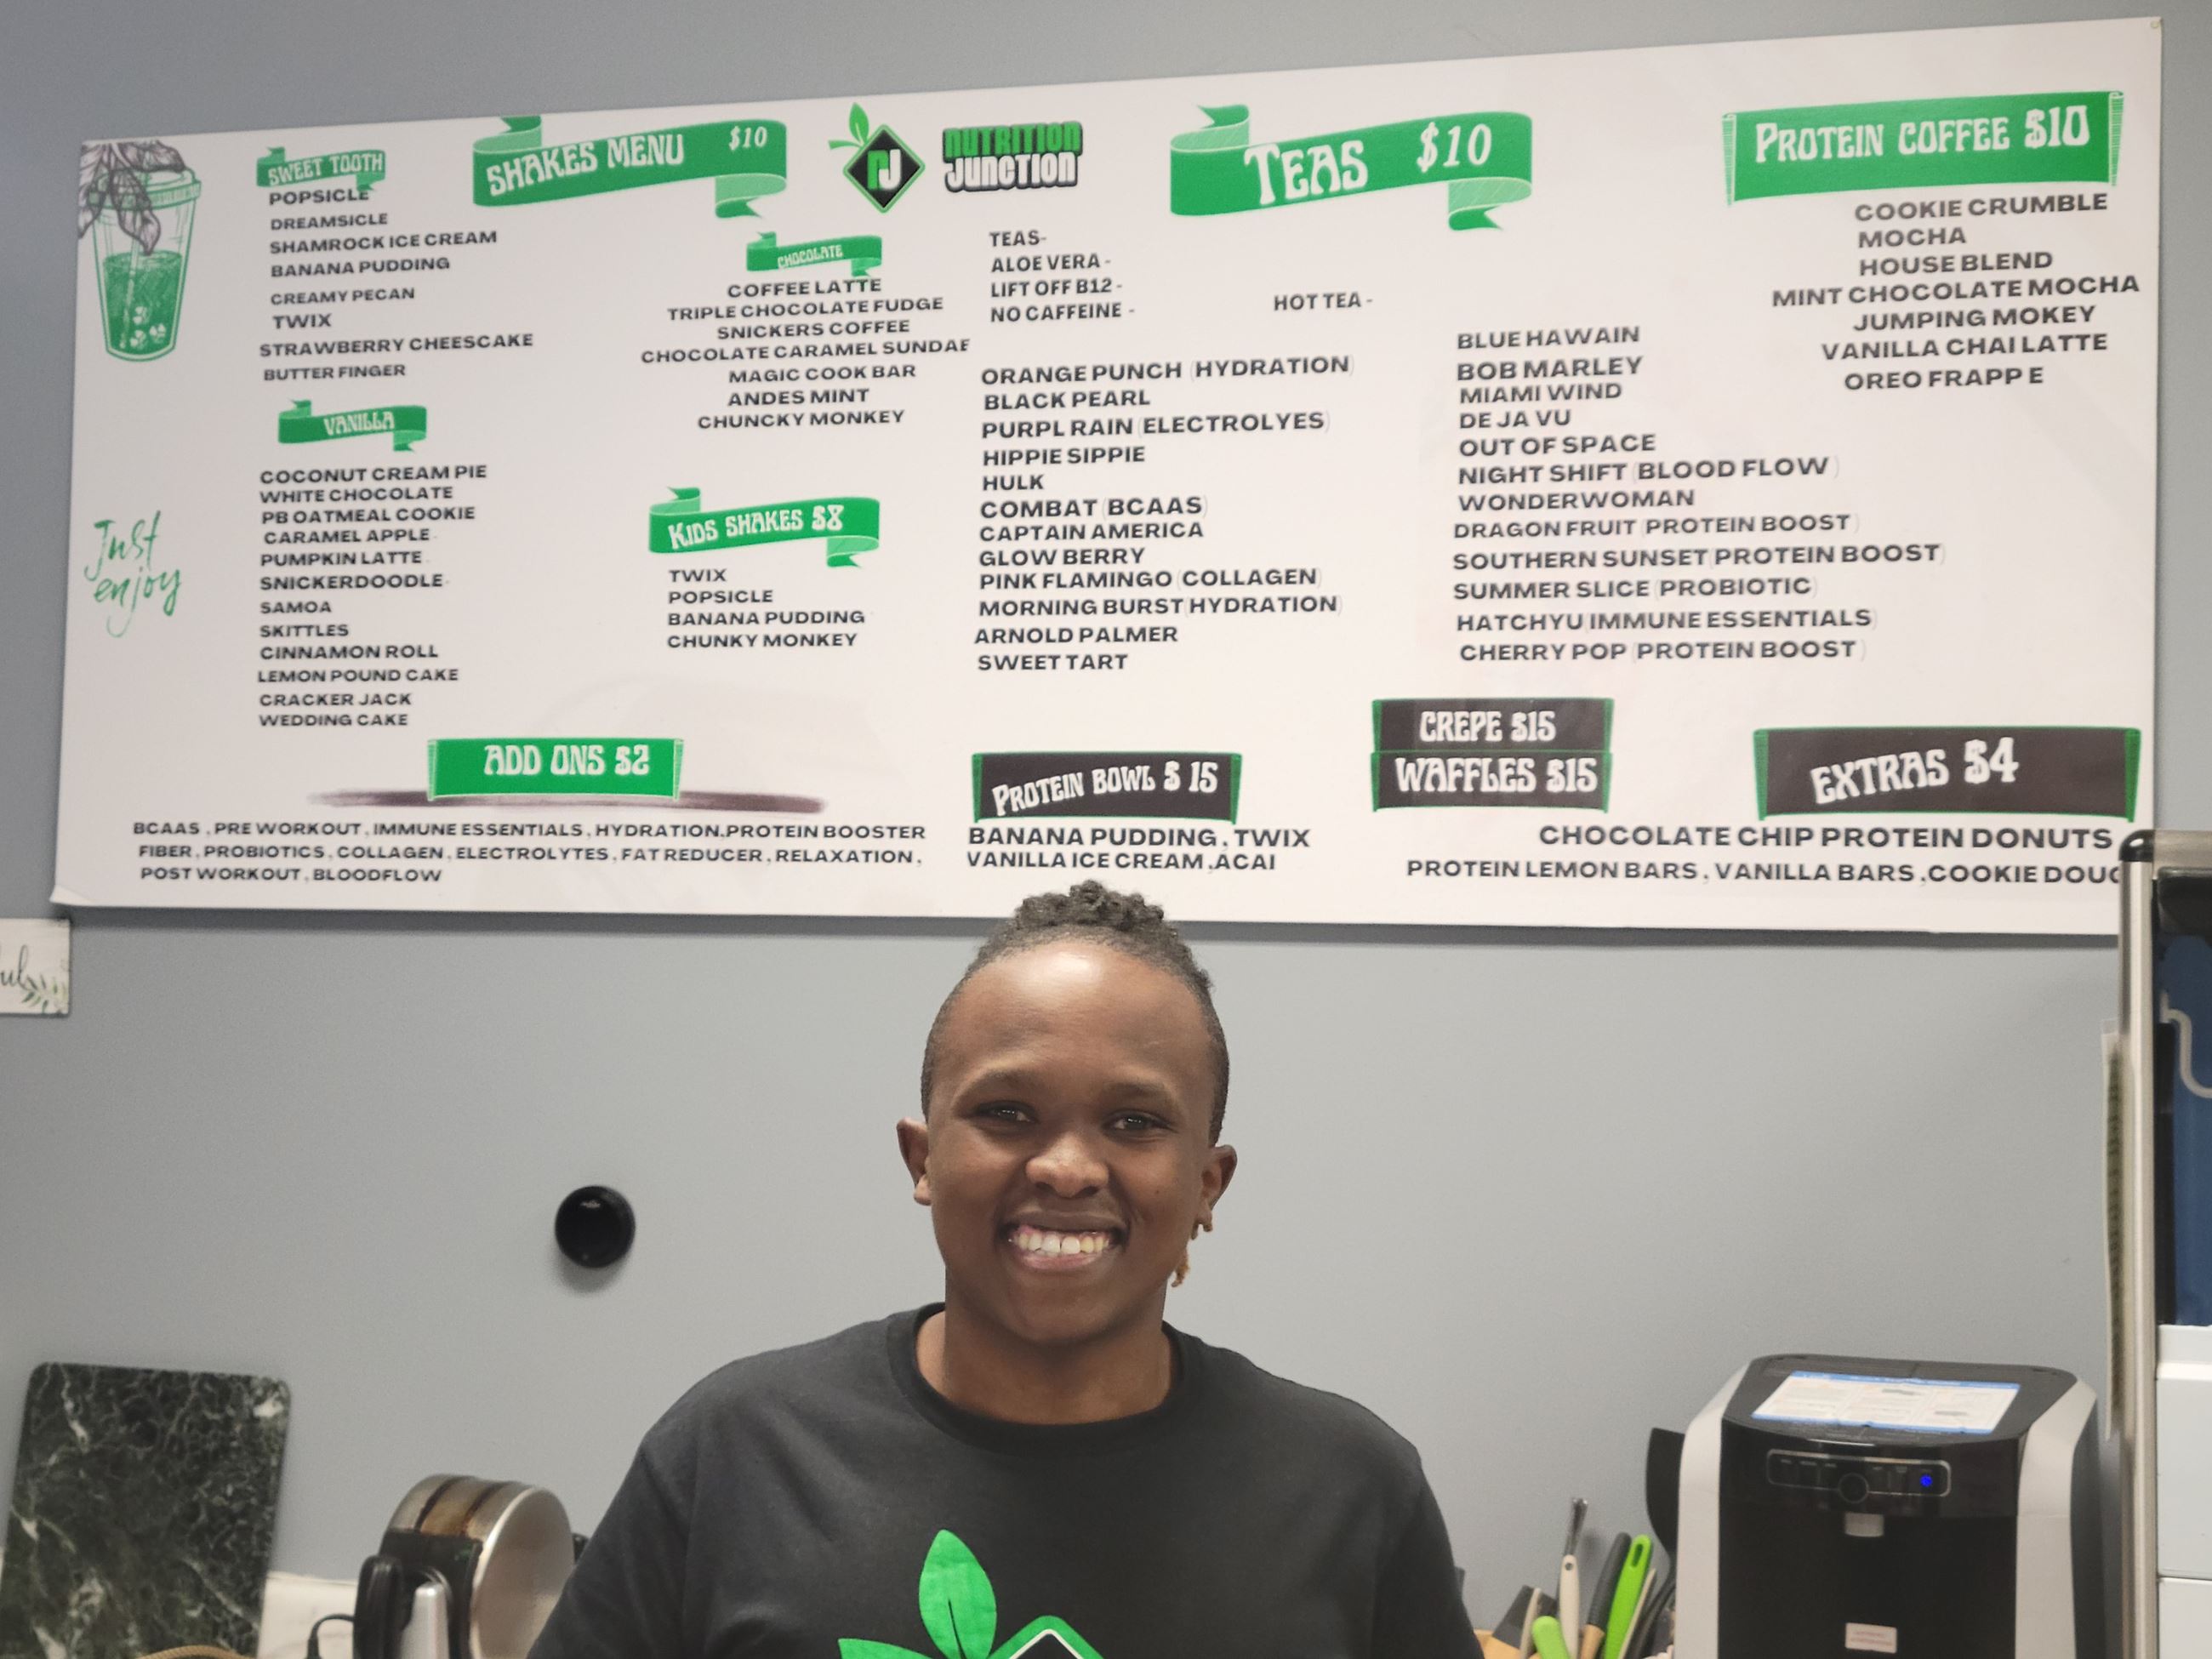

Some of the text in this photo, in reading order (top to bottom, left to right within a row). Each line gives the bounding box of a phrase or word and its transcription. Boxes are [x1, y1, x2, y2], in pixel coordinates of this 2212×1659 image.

[1755, 105, 2090, 162] PROTEIN COFFEE $10
[268, 152, 383, 185] SWEET TOOTH
[487, 126, 767, 197] SHAKES MENU $10
[1244, 122, 1492, 205] TEAS $10
[270, 188, 369, 205] POPSICLE
[1855, 193, 2107, 221] COOKIE CRUMBLE
[271, 214, 387, 231] DREAMSICLE
[271, 231, 497, 254] SHAMROCK ICE CREAM
[1859, 227, 1966, 248] MOCHA
[778, 245, 843, 269] CHOCOLATE
[1860, 252, 2053, 276] HOUSE BLEND
[271, 257, 450, 277] BANANA PUDDING
[271, 288, 414, 305] CREAMY PECAN
[727, 279, 881, 298] COFFEE LATTE
[1773, 276, 2140, 306] MINT CHOCOLATE MOCHA
[668, 298, 943, 320] TRIPLE CHOCOLATE FUDGE
[1854, 305, 2095, 331] JUMPING MOKEY
[273, 314, 331, 329] TWIX
[718, 320, 909, 339] SNICKERS COFFEE
[260, 334, 533, 356] STRAWBERRY CHEESCAKE
[1458, 327, 1639, 349] BLUE HAWAIN
[1822, 334, 2107, 360] VANILLA CHAI LATTE
[264, 364, 405, 381] BUTTER FINGER
[729, 365, 915, 383] MAGIC COOK BAR
[982, 362, 1181, 385] ORANGE PUNCH
[1457, 356, 1642, 380] BOB MARLEY
[728, 389, 869, 406] ANDES MINT
[985, 390, 1150, 410] BLACK PEARL
[1461, 383, 1622, 403] MIAMI WIND
[324, 411, 396, 436] VANILLA
[698, 410, 904, 429] CHUNCKY MONKEY
[983, 419, 1132, 438] PURPL RAIN
[983, 447, 1144, 466] HIPPIE SIPPIE
[260, 465, 487, 484] COCONUT CREAM PIE
[983, 475, 1043, 491] HULK
[1459, 464, 1627, 484] NIGHT SHIFT
[260, 487, 453, 504] WHITE CHOCOLATE
[981, 499, 1097, 518] COMBAT
[980, 522, 1203, 541] CAPTAIN AMERICA
[1455, 520, 1636, 538] DRAGON FRUIT
[83, 510, 161, 582] Just
[979, 548, 1144, 567] GLOW BERRY
[1454, 551, 1596, 570] SOUTHERN
[670, 569, 726, 582] TWIX
[981, 571, 1172, 589] PINK FLAMINGO
[669, 590, 772, 604] POPSICLE
[1454, 581, 1649, 600] SUMMER SLICE
[94, 567, 181, 638] enjoy
[260, 601, 332, 614] SAMOA
[980, 600, 1097, 616] MORNING
[669, 611, 864, 625] BANANA PUDDING
[260, 624, 349, 637] SKITTLES
[975, 627, 1177, 643] ARNOLD PALMER
[668, 634, 857, 648] CHUNKY MONKEY
[260, 645, 438, 659] CINNAMON ROLL
[1460, 643, 1627, 661] CHERRY POP
[978, 654, 1127, 670] SWEET TART
[258, 669, 458, 682] LEMON POUND CAKE
[259, 693, 411, 706] CRACKER JACK
[259, 714, 408, 727] WEDDING CAKE
[1419, 711, 1556, 742] CREPE $15
[484, 744, 650, 775] ADD ONS $2
[1395, 757, 1598, 792] WAFFLES $15
[1810, 737, 2019, 804] EXTRAS $4
[992, 772, 1085, 816] PROTEIN
[1092, 765, 1155, 794] BOWL
[824, 825, 925, 839] BOOSTER
[969, 828, 1084, 845] BANANA
[1234, 830, 1309, 847] TWIX
[1540, 826, 2112, 849] CHOCOLATE CHIP PROTEIN DONUTS
[967, 852, 1203, 869] VANILLA ICE CREAM
[1408, 860, 1617, 878] PROTEIN LEMON
[141, 867, 191, 880] POST
[313, 869, 442, 881] BLOODFLOW
[1715, 864, 1831, 881] VANILLA
